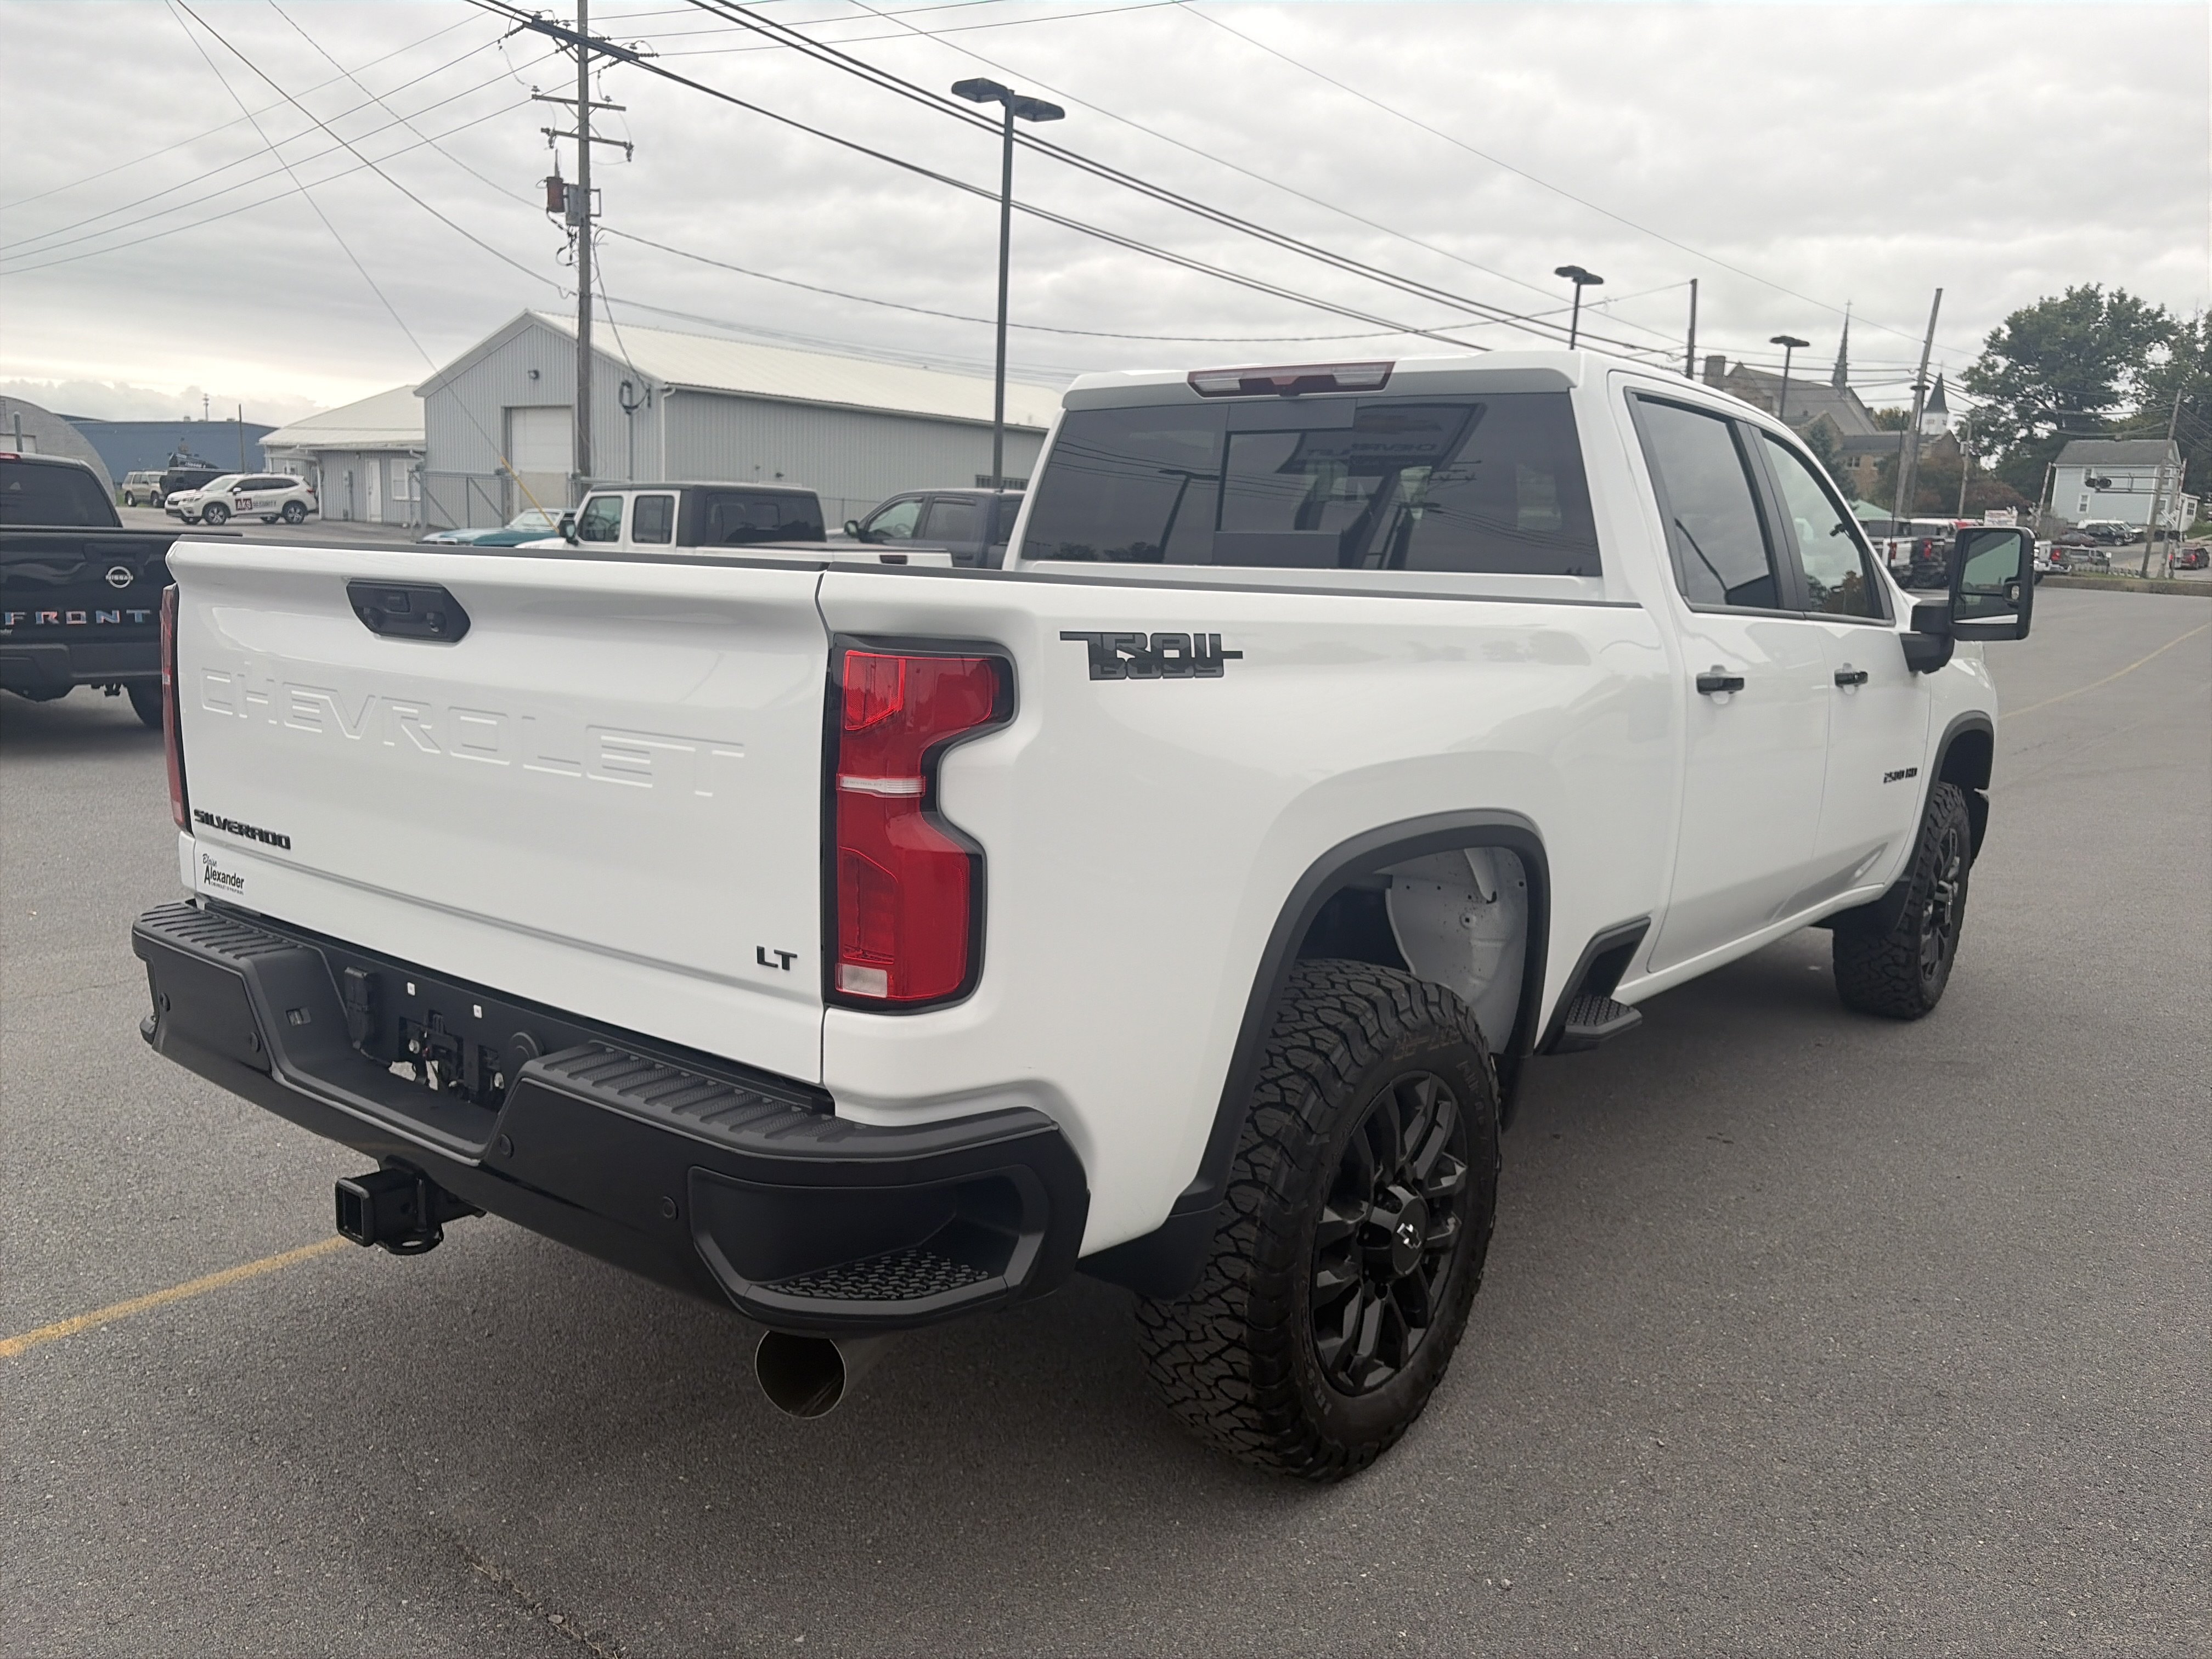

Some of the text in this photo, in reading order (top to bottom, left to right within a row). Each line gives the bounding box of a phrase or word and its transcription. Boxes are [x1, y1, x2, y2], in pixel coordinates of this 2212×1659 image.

[4, 609, 151, 625] FRONT
[201, 667, 745, 797] CHEVROLET
[1905, 768, 1918, 778] HD
[193, 808, 291, 850] SILVERADO
[204, 865, 245, 889] Alexander
[757, 945, 798, 971] LT
